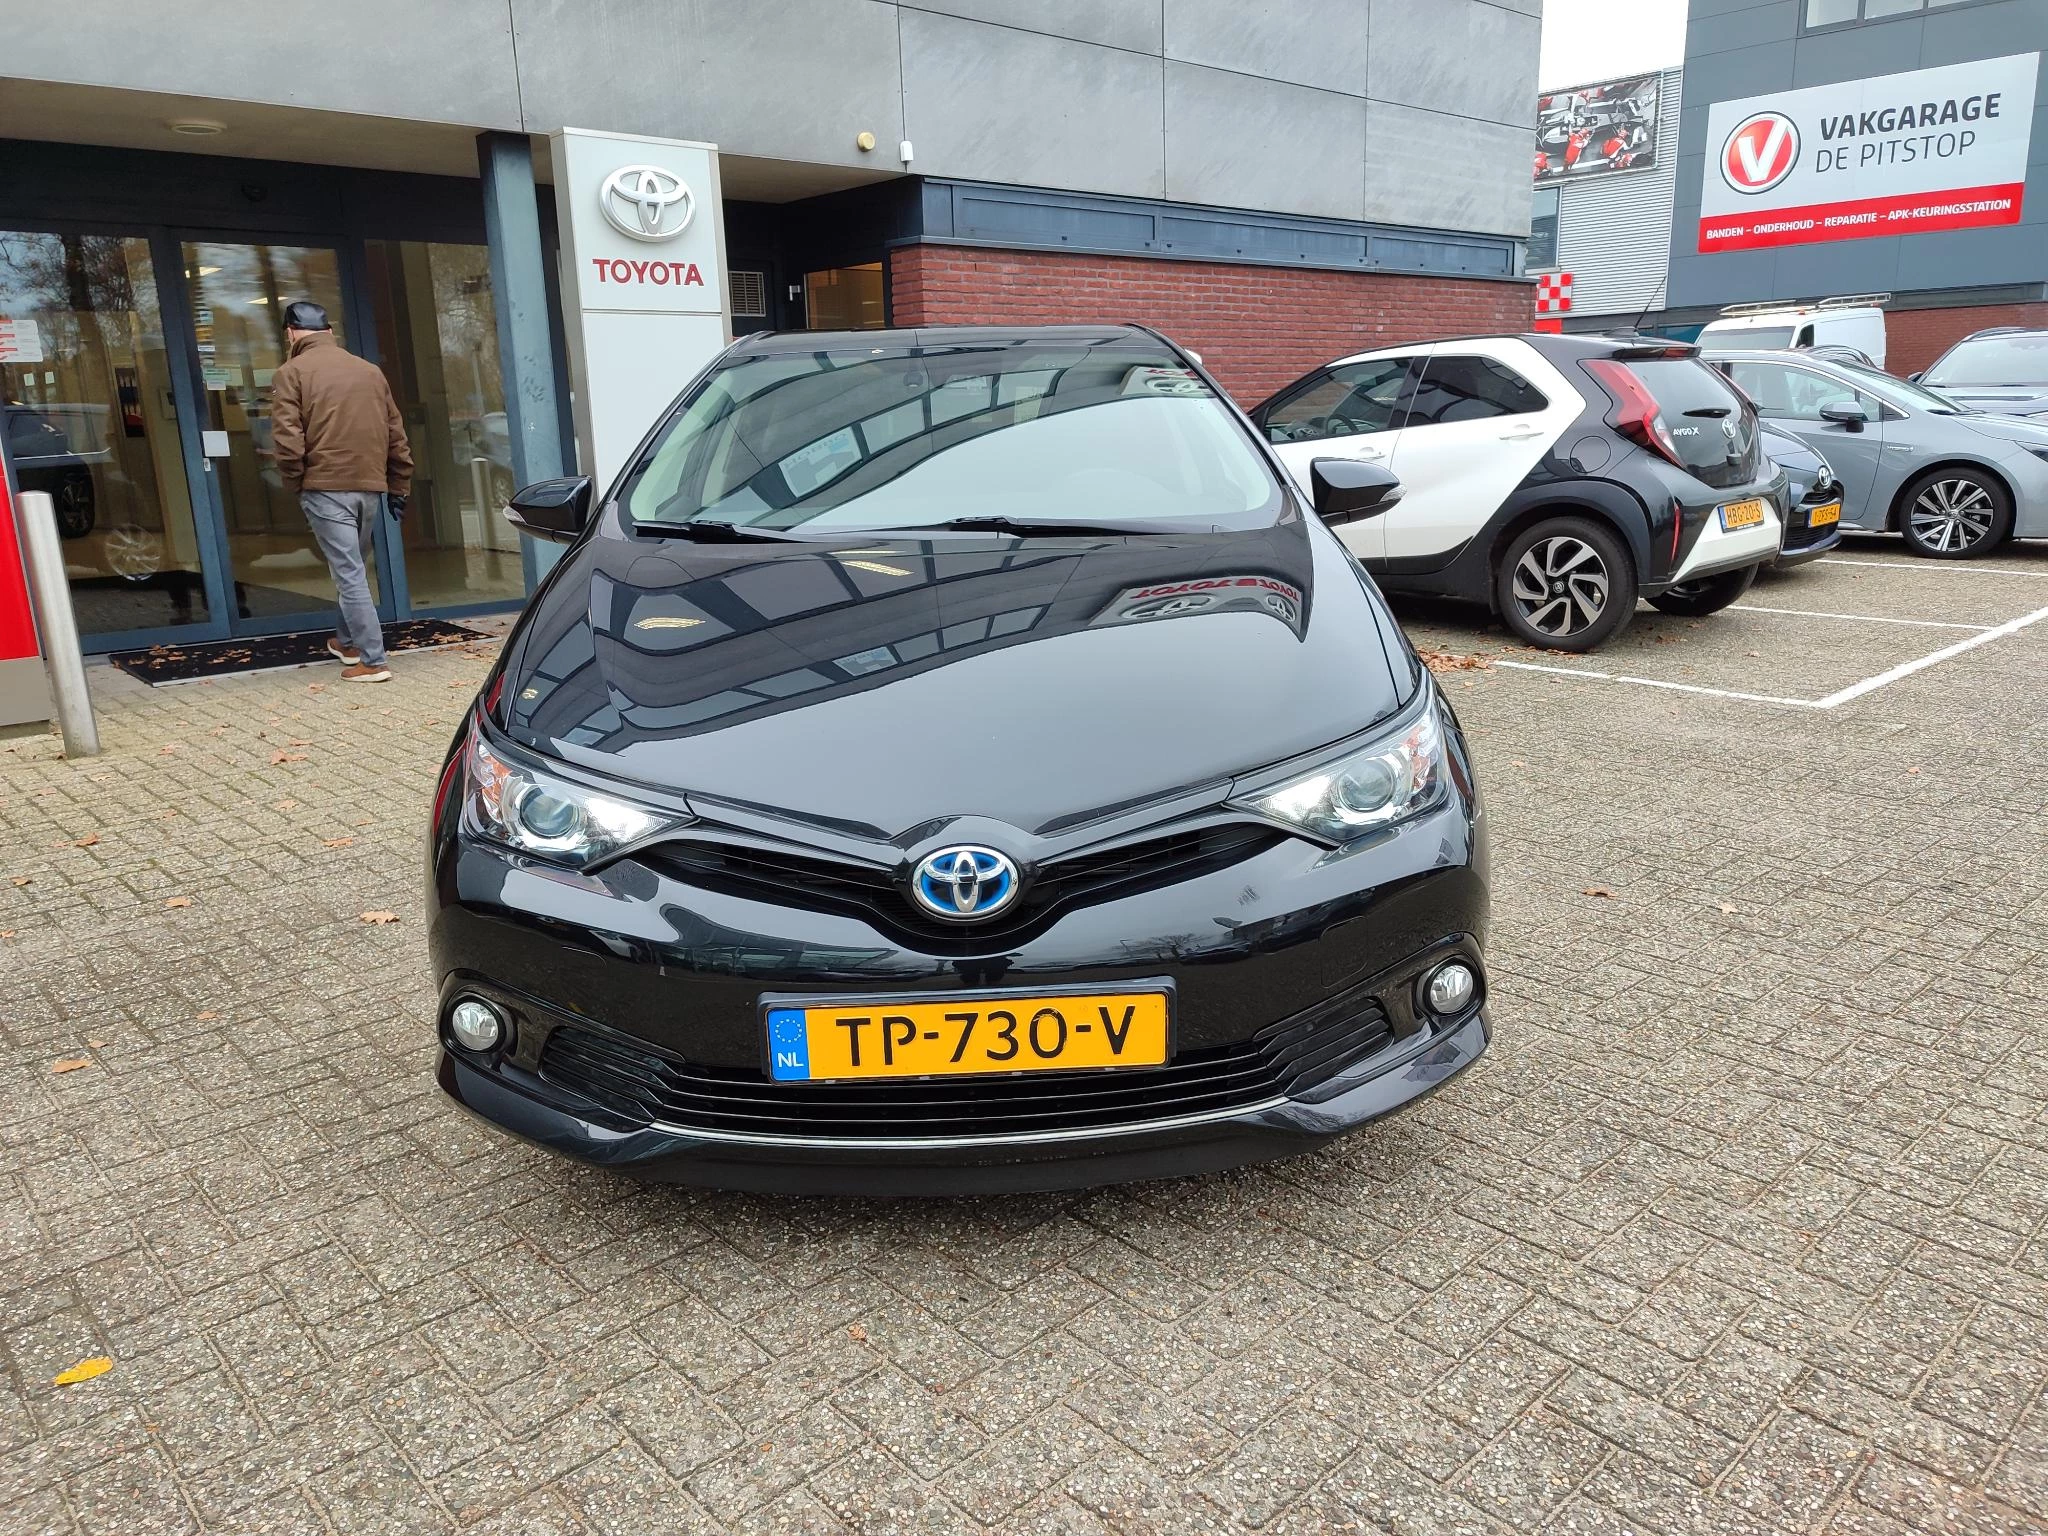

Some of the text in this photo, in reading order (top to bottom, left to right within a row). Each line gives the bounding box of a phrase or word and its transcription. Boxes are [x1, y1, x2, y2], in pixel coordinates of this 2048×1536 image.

[1820, 92, 2001, 141] VAKGARAGE
[1815, 130, 1976, 173] DE PITSTOP
[1706, 226, 1744, 240] BANDEN
[1753, 219, 1814, 235] ONDERHOUD
[1824, 212, 1877, 228] REPARATIE
[1887, 198, 2012, 221] APK-KEURINGSSTATION
[592, 258, 704, 286] TOYOTA
[835, 1005, 1136, 1067] TP-730-V
[777, 1052, 804, 1068] NL
